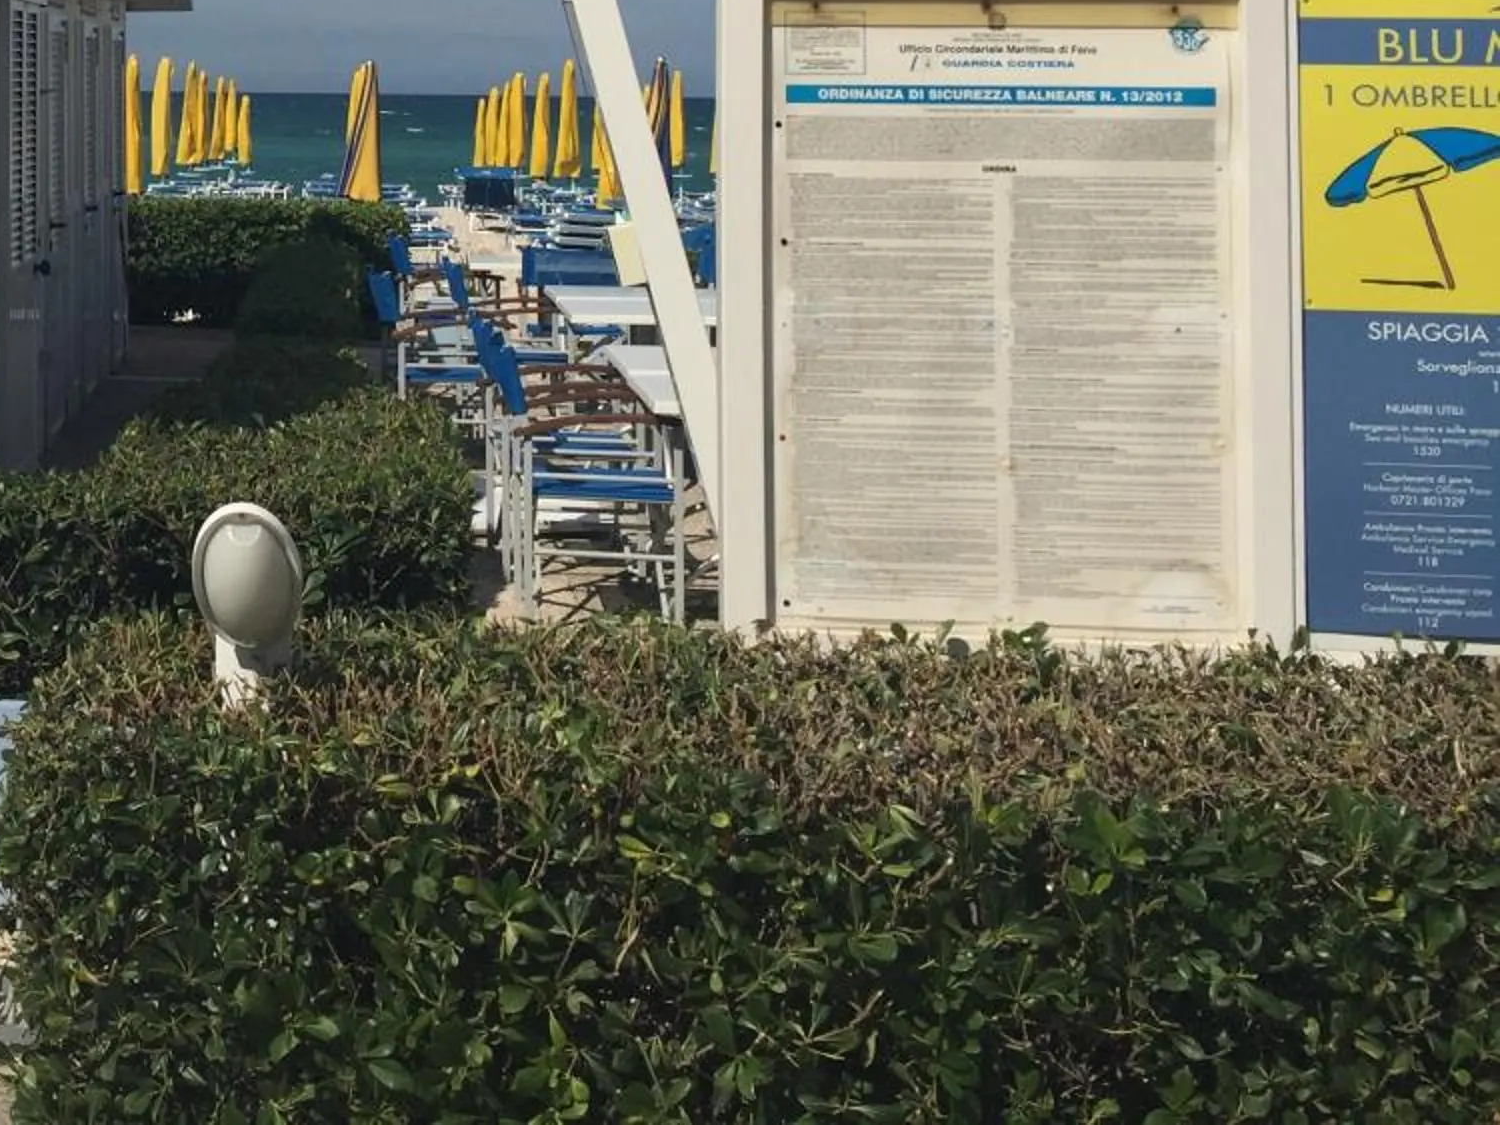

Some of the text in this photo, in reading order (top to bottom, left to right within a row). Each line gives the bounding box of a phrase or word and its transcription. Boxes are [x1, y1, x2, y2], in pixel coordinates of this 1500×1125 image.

[1379, 27, 1463, 64] BLU
[818, 88, 904, 100] ORDINANZA
[908, 89, 924, 100] DI
[928, 88, 1012, 101] SICUREZZA
[1016, 90, 1097, 101] BALNEARE
[1121, 91, 1184, 103] 13/2012
[1324, 84, 1333, 106] 1
[1367, 321, 1490, 343] SPIAGGIA
